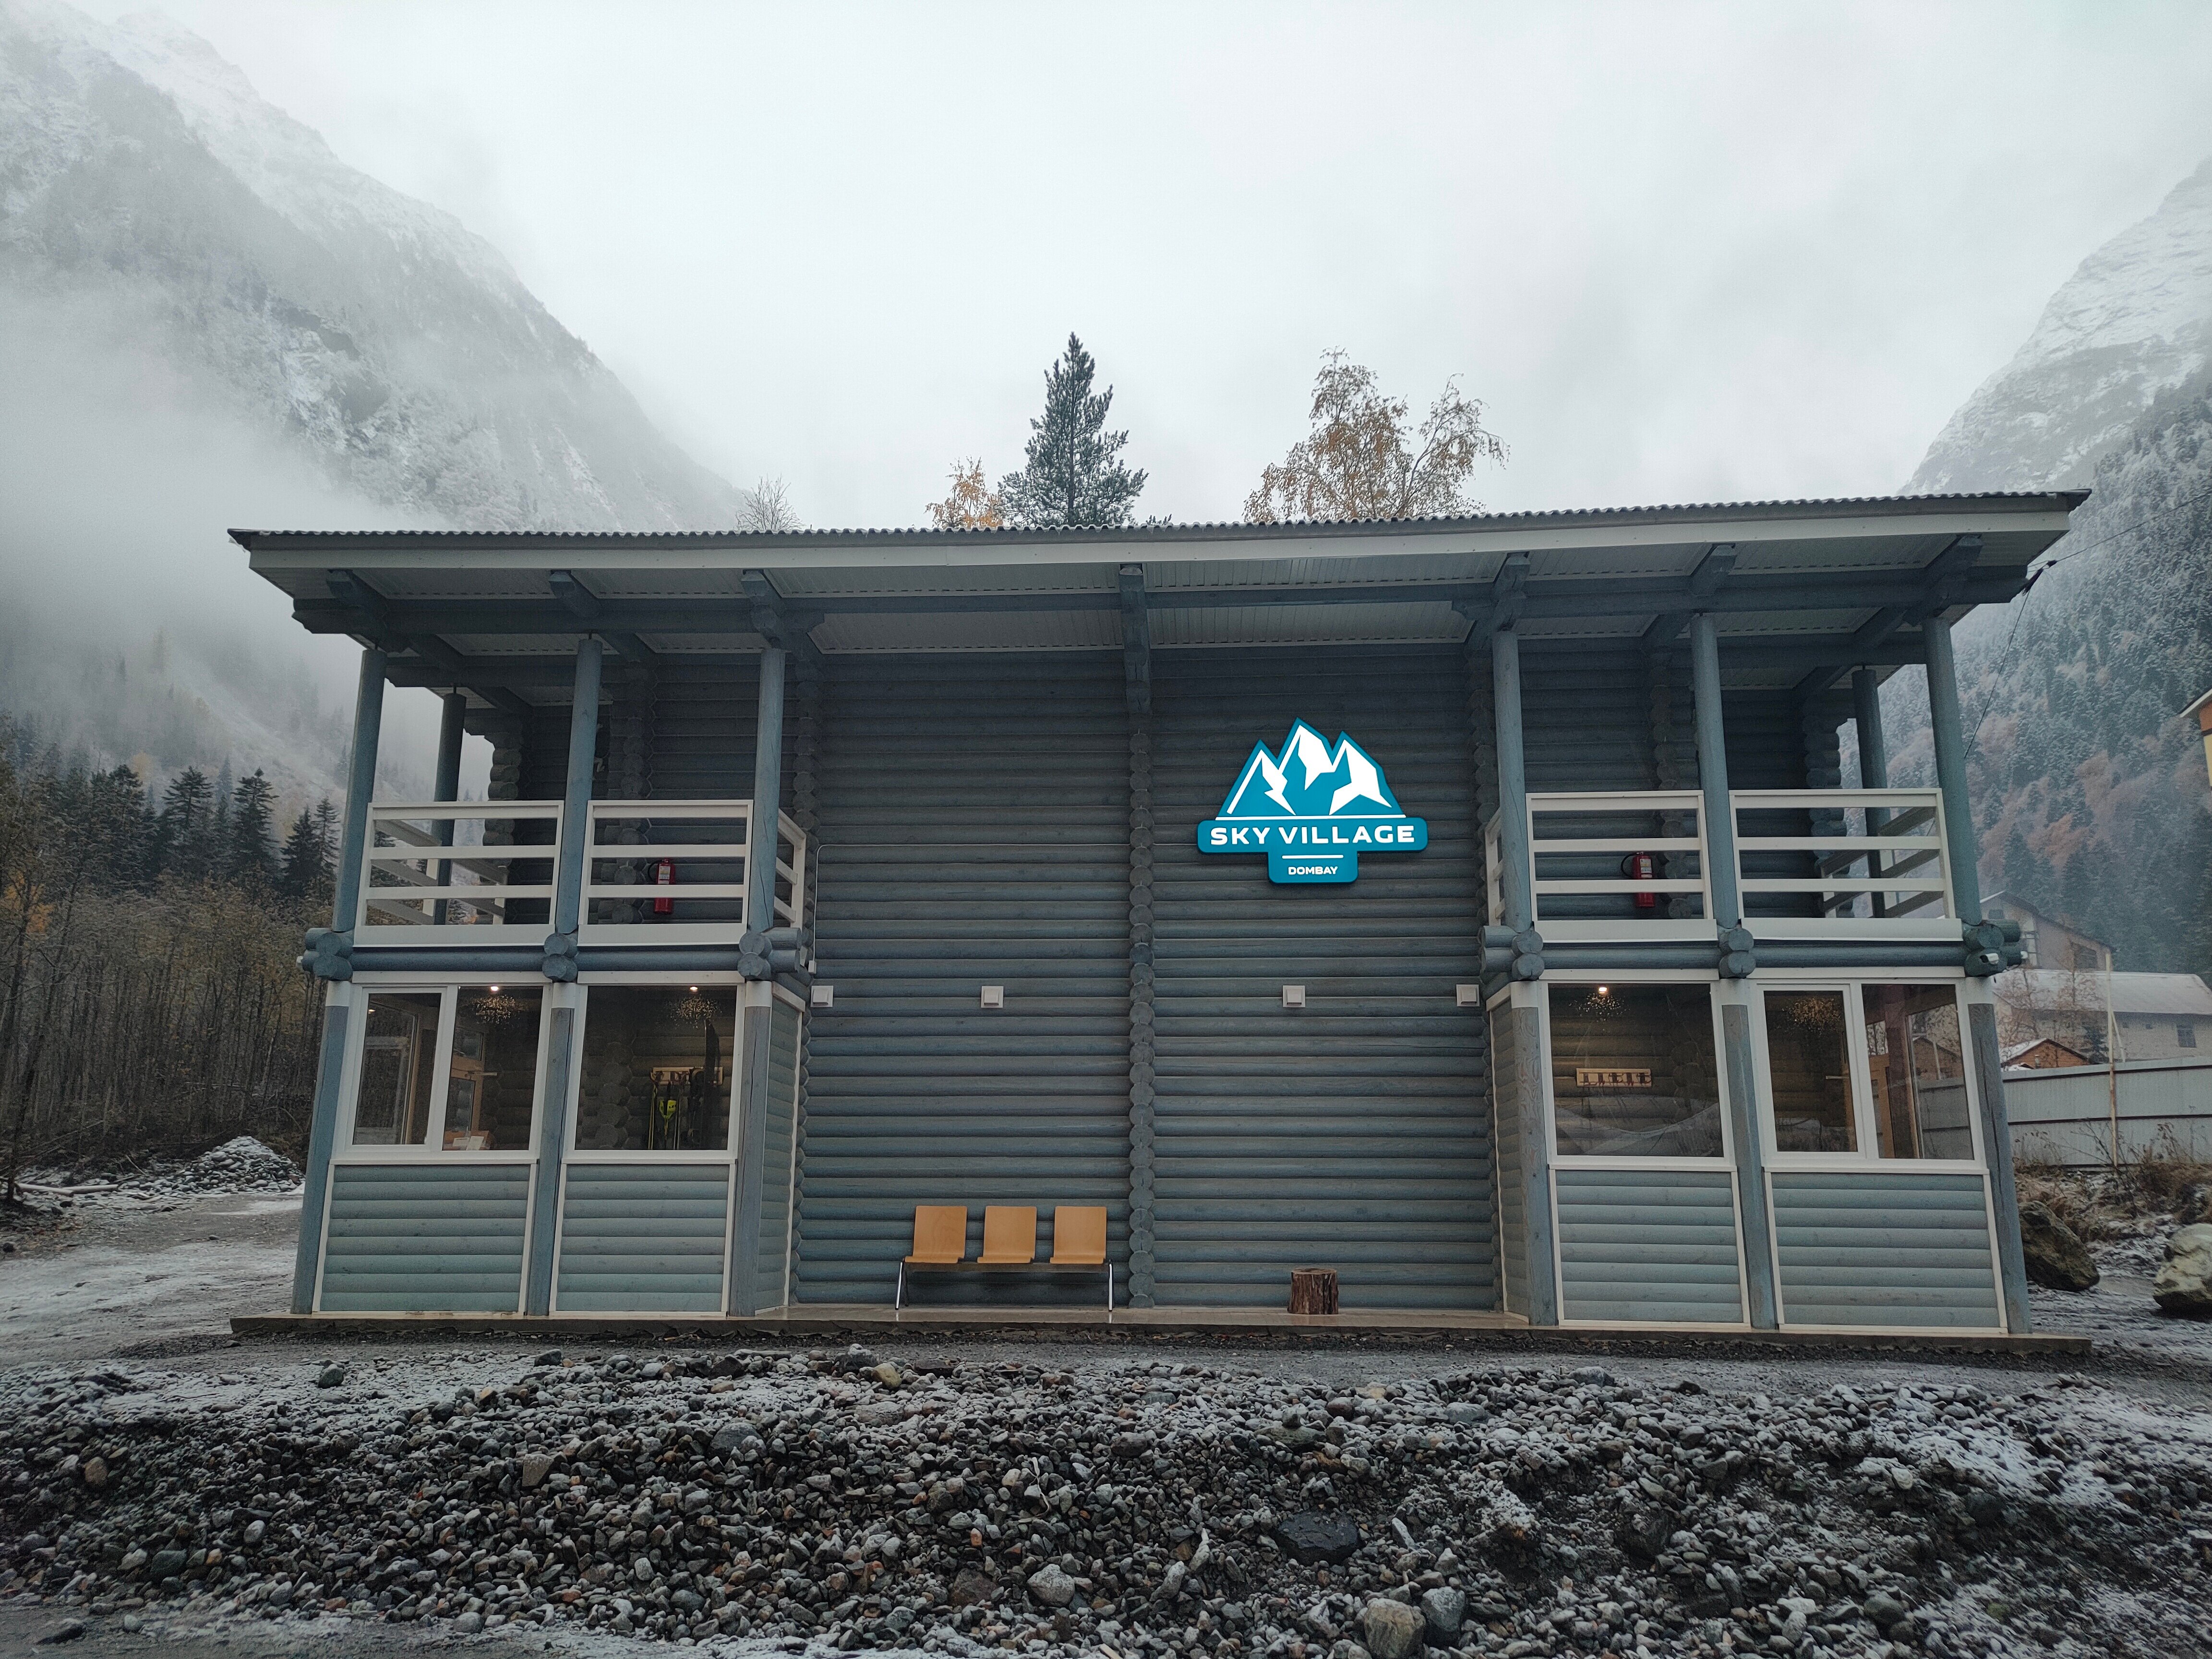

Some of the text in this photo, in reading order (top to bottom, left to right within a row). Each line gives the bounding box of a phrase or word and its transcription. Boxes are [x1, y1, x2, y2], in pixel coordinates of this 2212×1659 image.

[1211, 825, 1415, 845] SKY VILLAGE
[1288, 866, 1338, 875] DOMBAY
